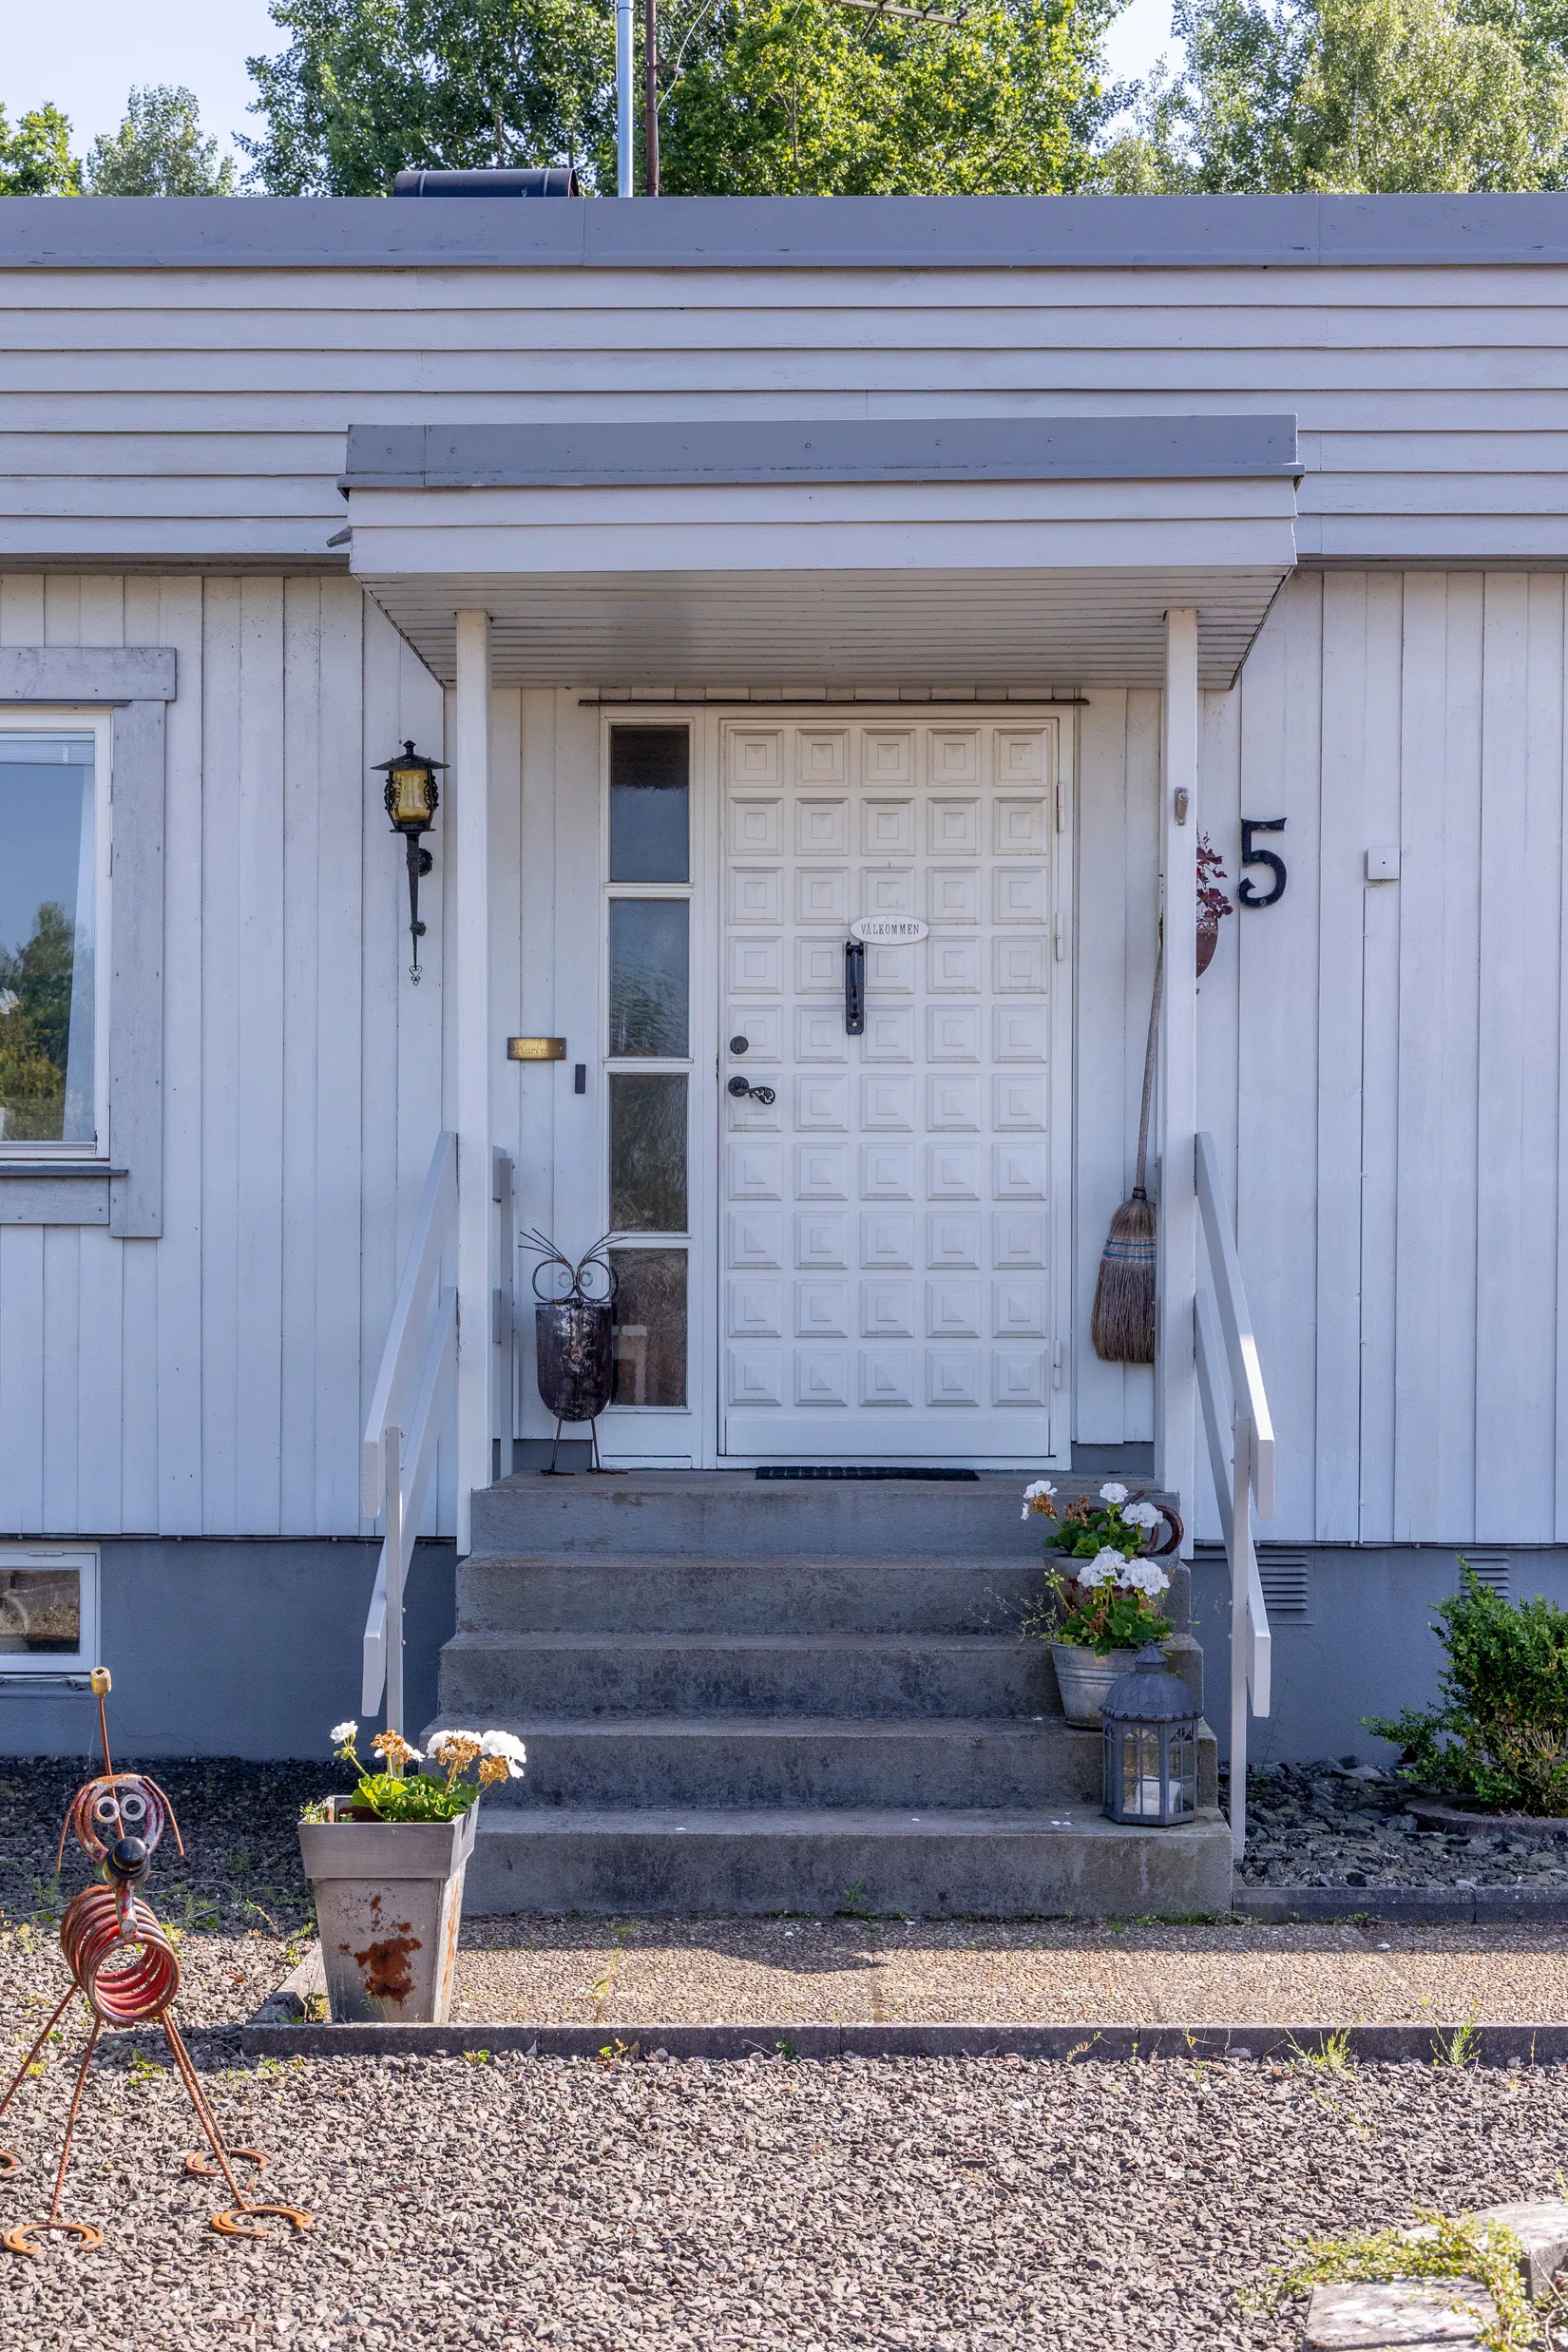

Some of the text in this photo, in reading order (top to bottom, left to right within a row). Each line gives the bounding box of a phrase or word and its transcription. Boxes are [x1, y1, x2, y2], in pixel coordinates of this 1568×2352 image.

[1237, 817, 1288, 908] 5
[861, 922, 919, 935] VÄLKOMMEN
[515, 1042, 556, 1055] Karlss
